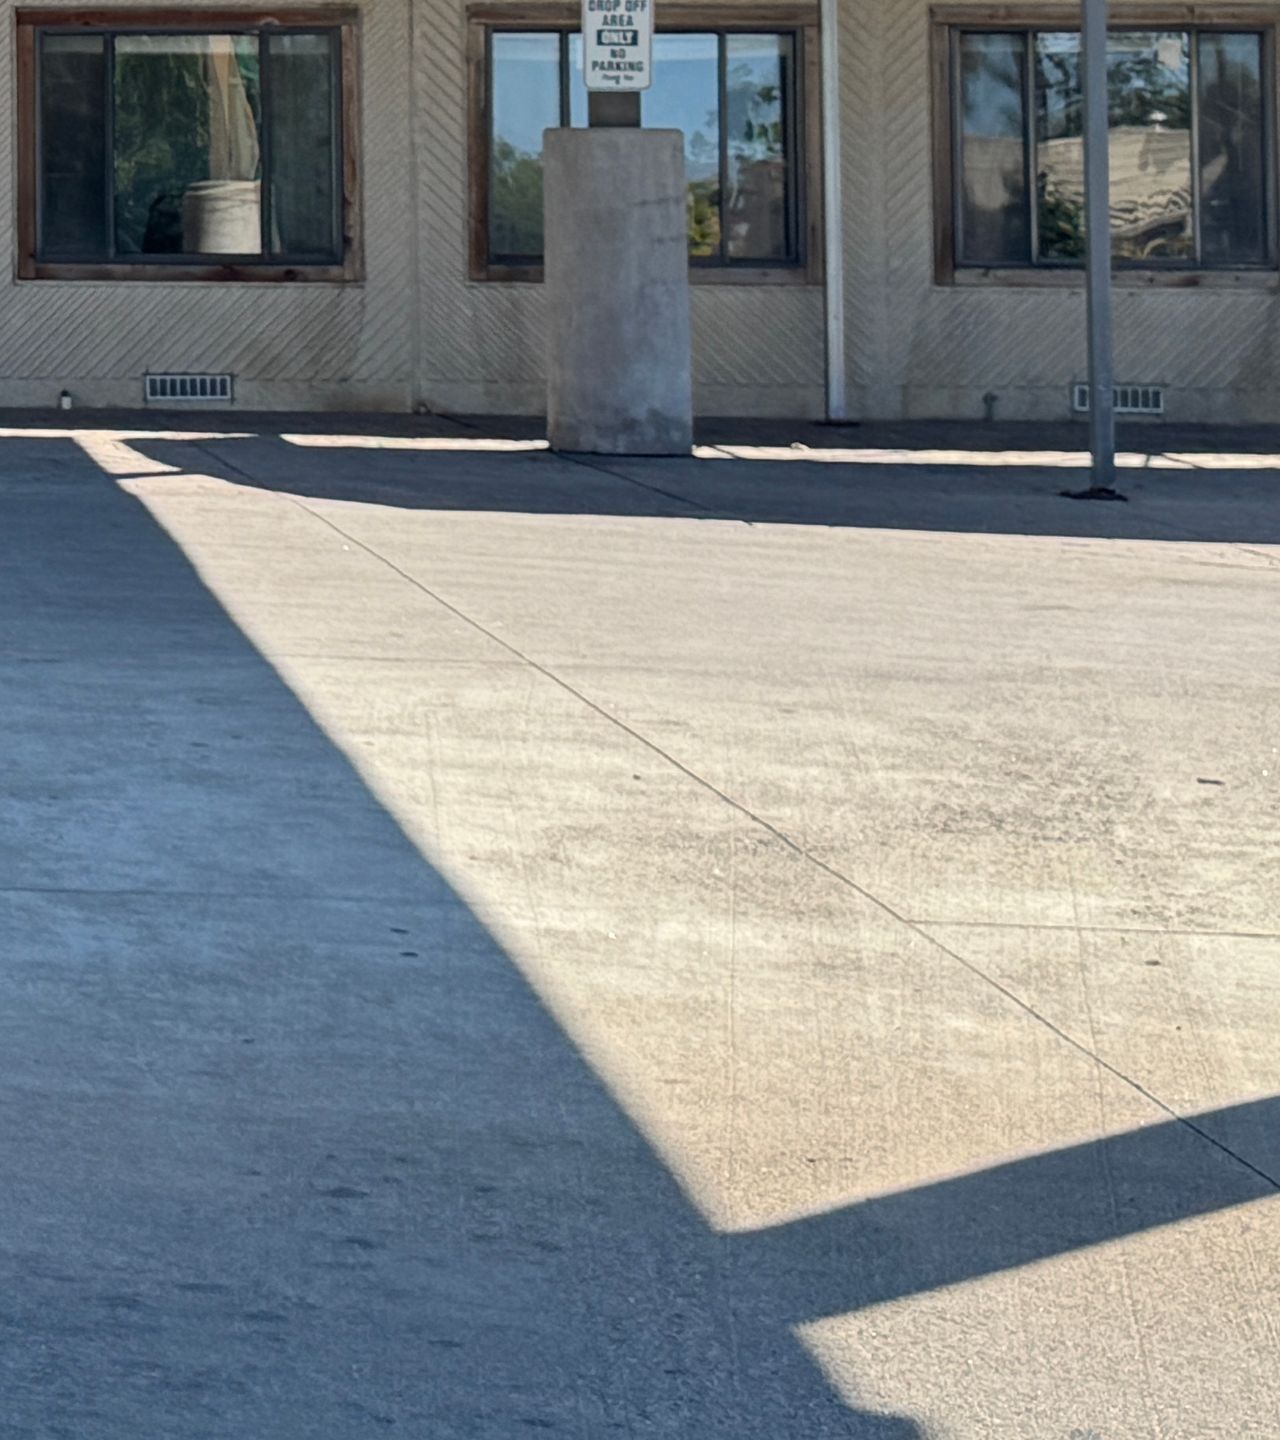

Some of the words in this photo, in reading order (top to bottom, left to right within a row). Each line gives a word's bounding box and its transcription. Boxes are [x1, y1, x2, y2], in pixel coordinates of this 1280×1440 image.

[625, 0, 648, 12] OFF
[602, 14, 634, 27] AREA
[601, 29, 634, 44] ONLY
[610, 48, 626, 59] NO
[591, 61, 644, 72] PARKING
